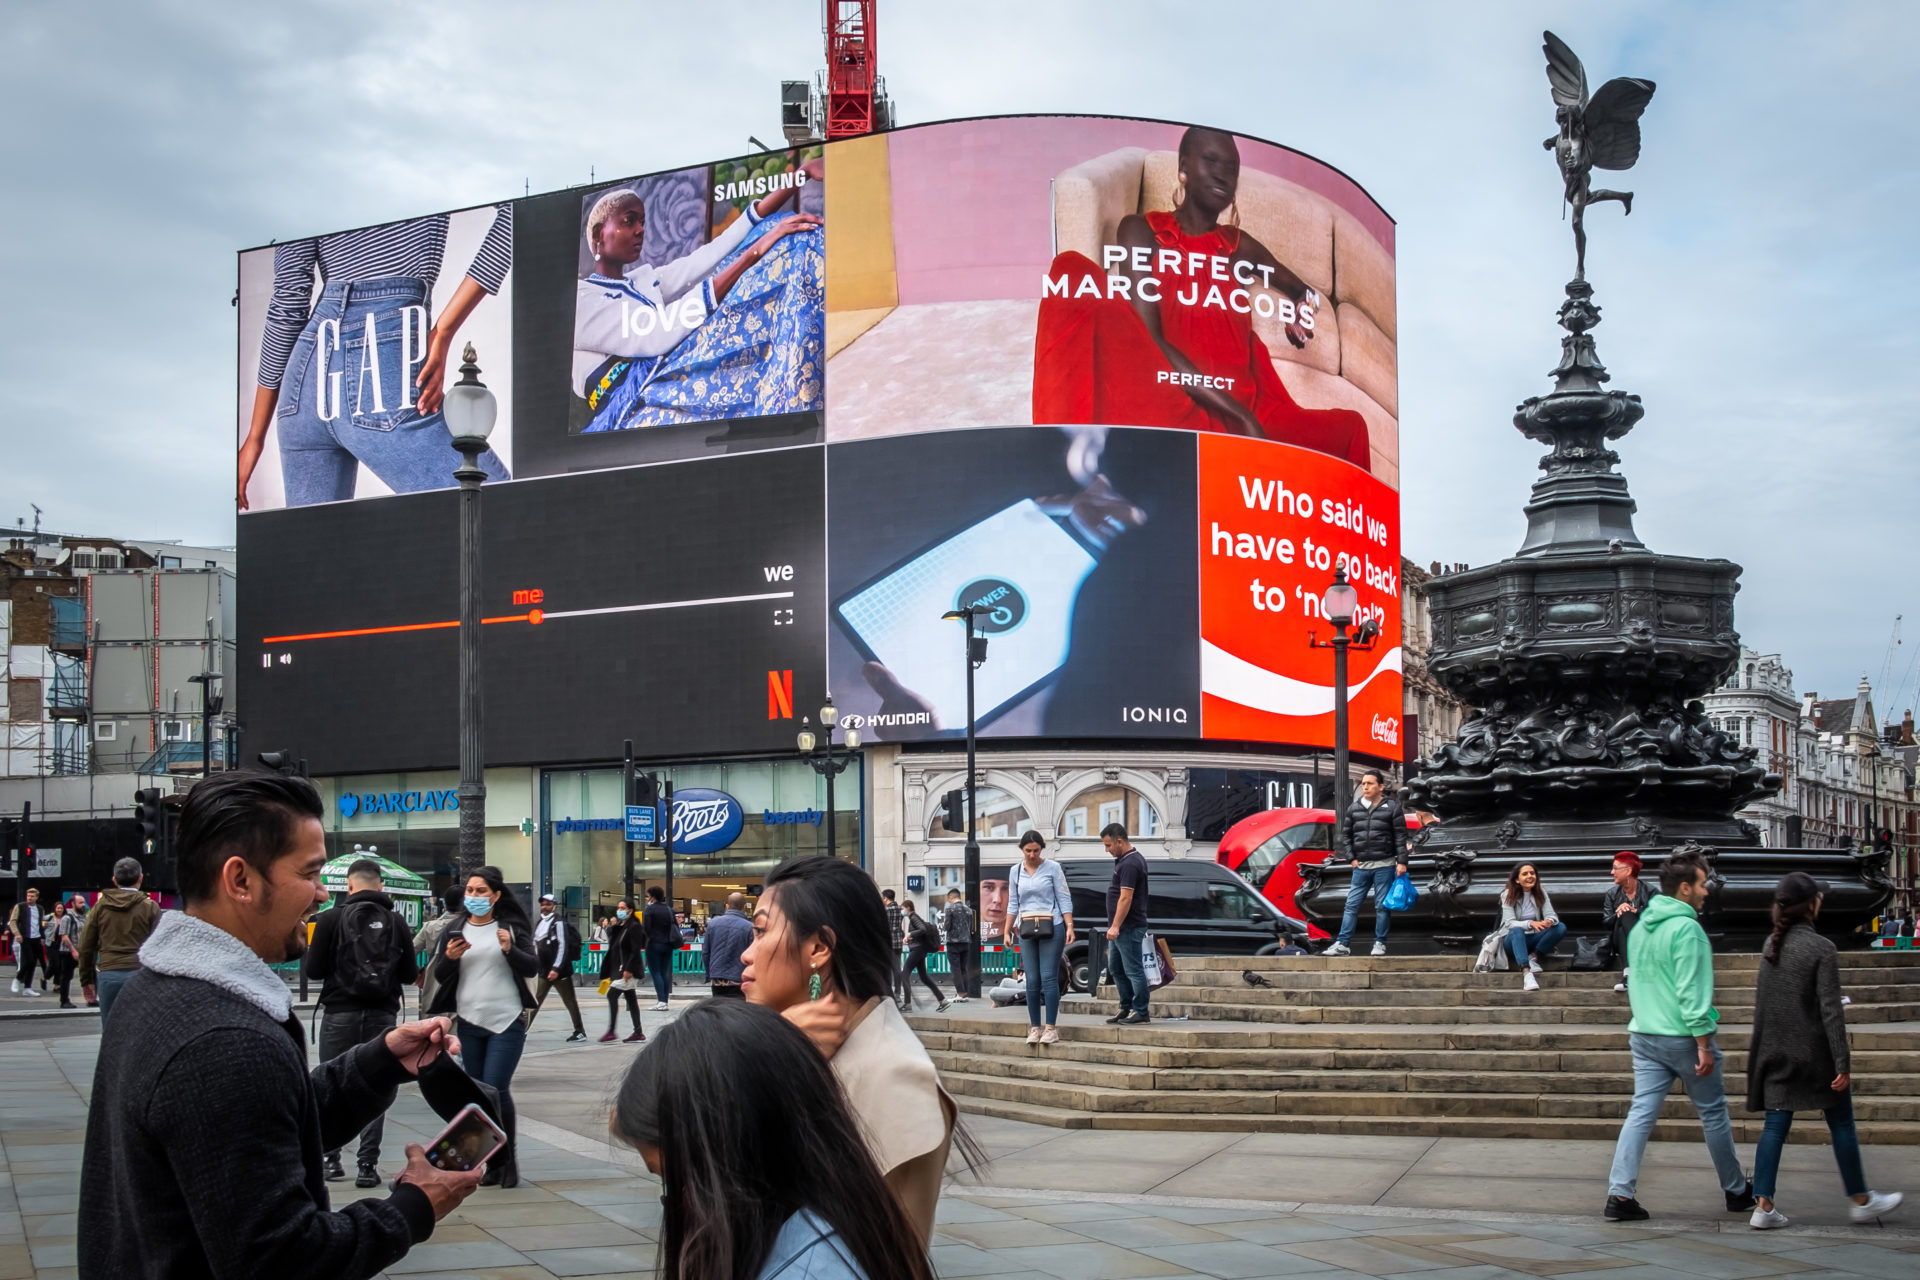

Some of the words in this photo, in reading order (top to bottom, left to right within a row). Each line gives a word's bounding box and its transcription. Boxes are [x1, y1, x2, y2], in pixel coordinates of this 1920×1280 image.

[714, 169, 806, 202] SAMSUNG
[1103, 245, 1275, 289] PERFECT
[621, 297, 706, 339] love
[1041, 273, 1162, 302] MARC
[1177, 281, 1316, 330] JACOBS
[316, 305, 427, 421] GAP
[1157, 370, 1235, 391] PERFECT
[1238, 475, 1314, 519] Who
[1321, 498, 1363, 534] said
[1366, 515, 1387, 547] we
[764, 564, 794, 582] we
[1211, 522, 1295, 564] have
[1303, 536, 1331, 571] to
[1336, 551, 1361, 583] go
[1365, 554, 1397, 598] back
[512, 588, 544, 605] me
[967, 586, 1011, 610] OWER
[1250, 578, 1286, 613] to
[768, 669, 793, 720] N
[867, 712, 930, 727] HYUNDAI
[1123, 707, 1187, 723] IONIQ
[362, 789, 460, 814] BARCLAYS
[764, 807, 823, 827] beauty
[556, 816, 625, 835] pharmac
[660, 799, 730, 843] Boots
